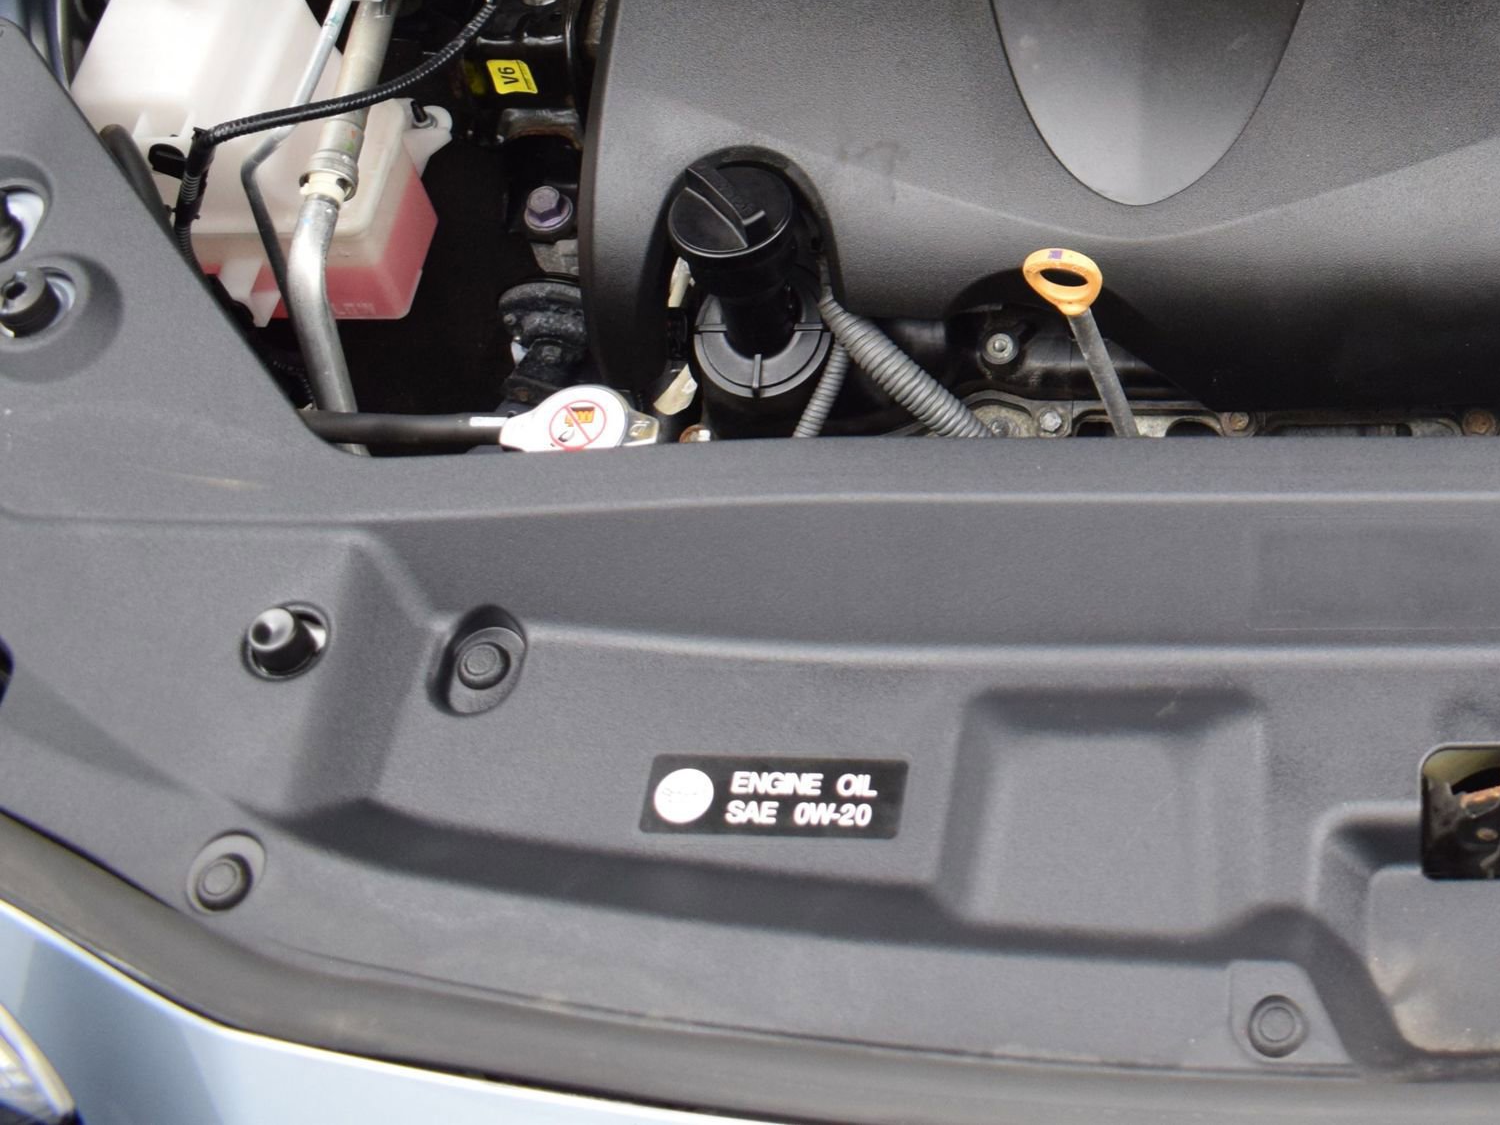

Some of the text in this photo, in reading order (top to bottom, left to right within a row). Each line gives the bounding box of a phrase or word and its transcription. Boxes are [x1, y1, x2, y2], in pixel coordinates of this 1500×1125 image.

[497, 66, 520, 85] V6
[730, 771, 878, 797] ENGINE OIL
[725, 800, 872, 826] SAE 0W-20
